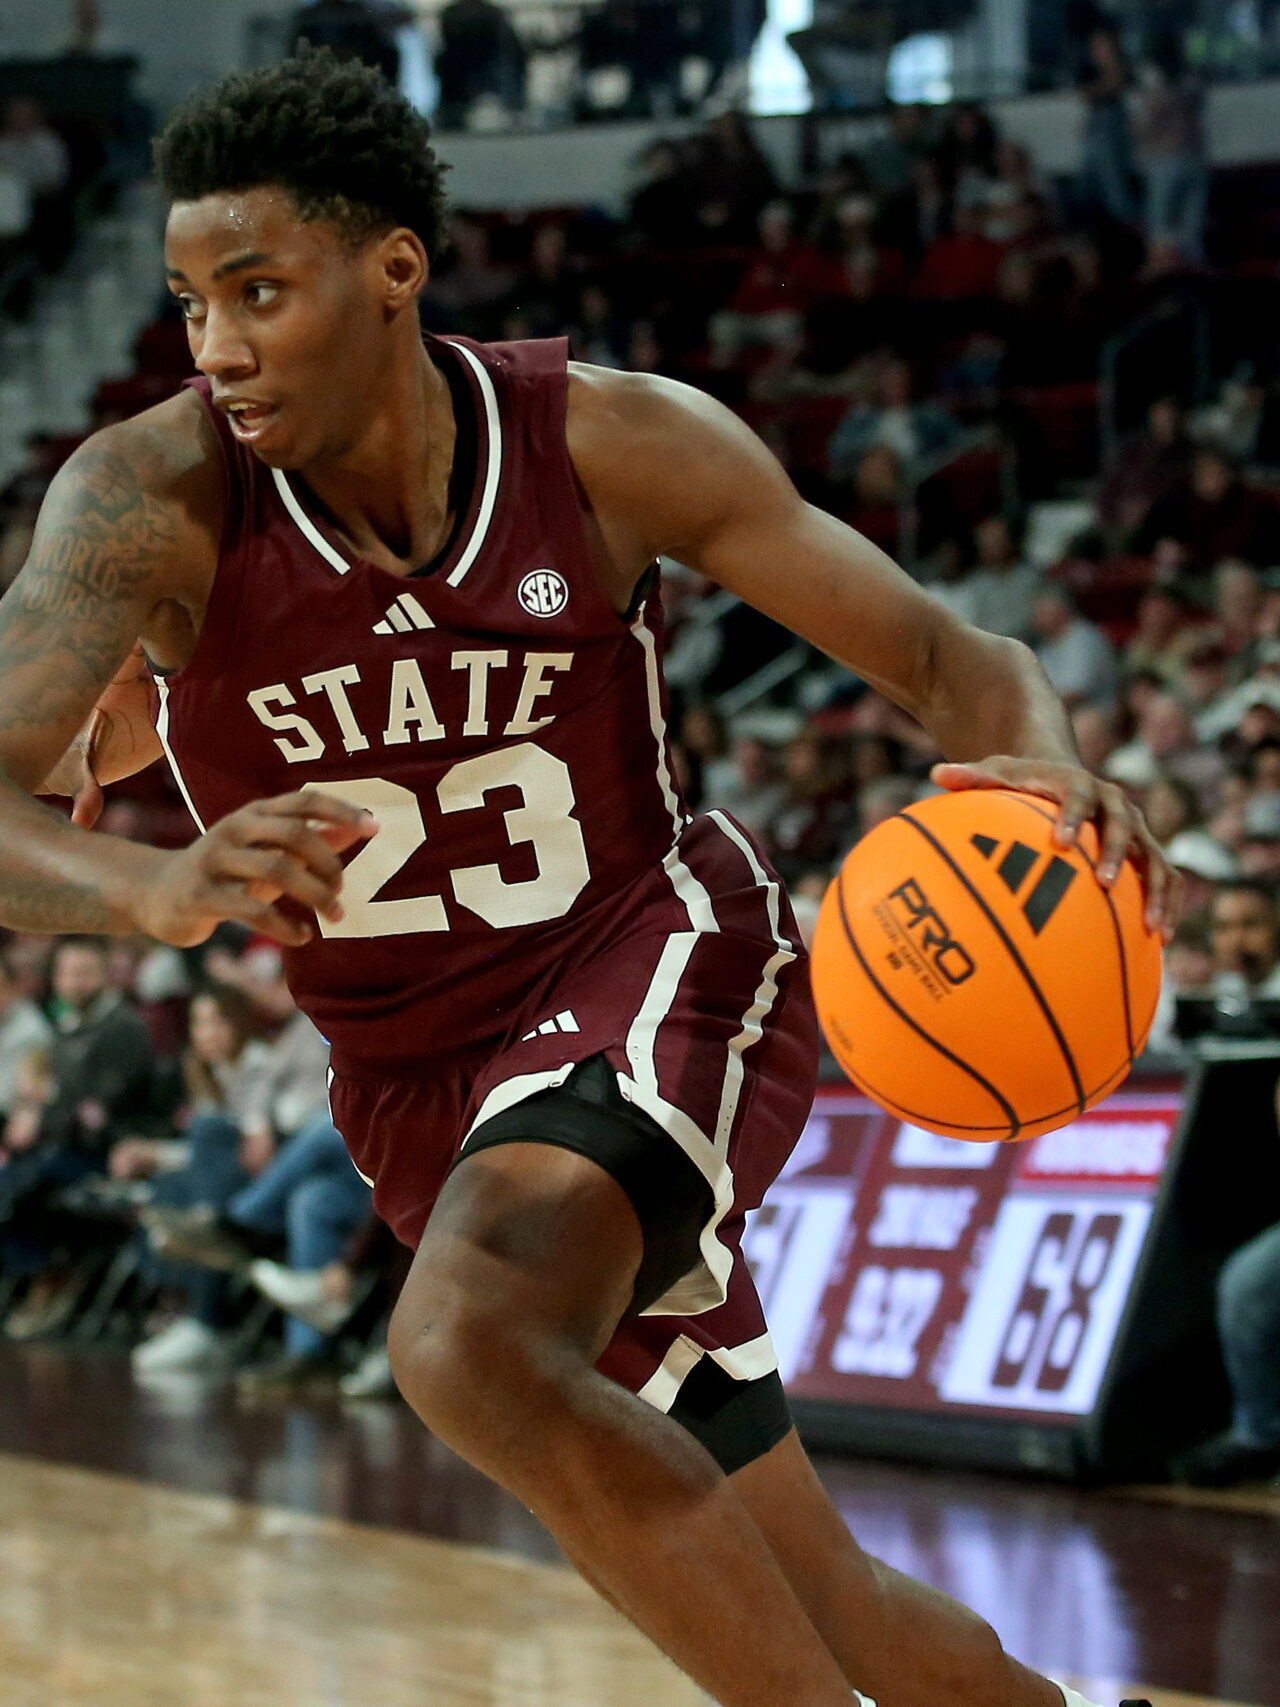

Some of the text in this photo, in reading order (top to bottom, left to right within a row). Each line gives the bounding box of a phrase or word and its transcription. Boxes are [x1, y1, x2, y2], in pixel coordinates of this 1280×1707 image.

[522, 573, 564, 613] SEC
[246, 650, 575, 763] STATE
[299, 742, 591, 938] 23
[888, 877, 976, 985] PRO
[991, 1213, 1124, 1391] 68
